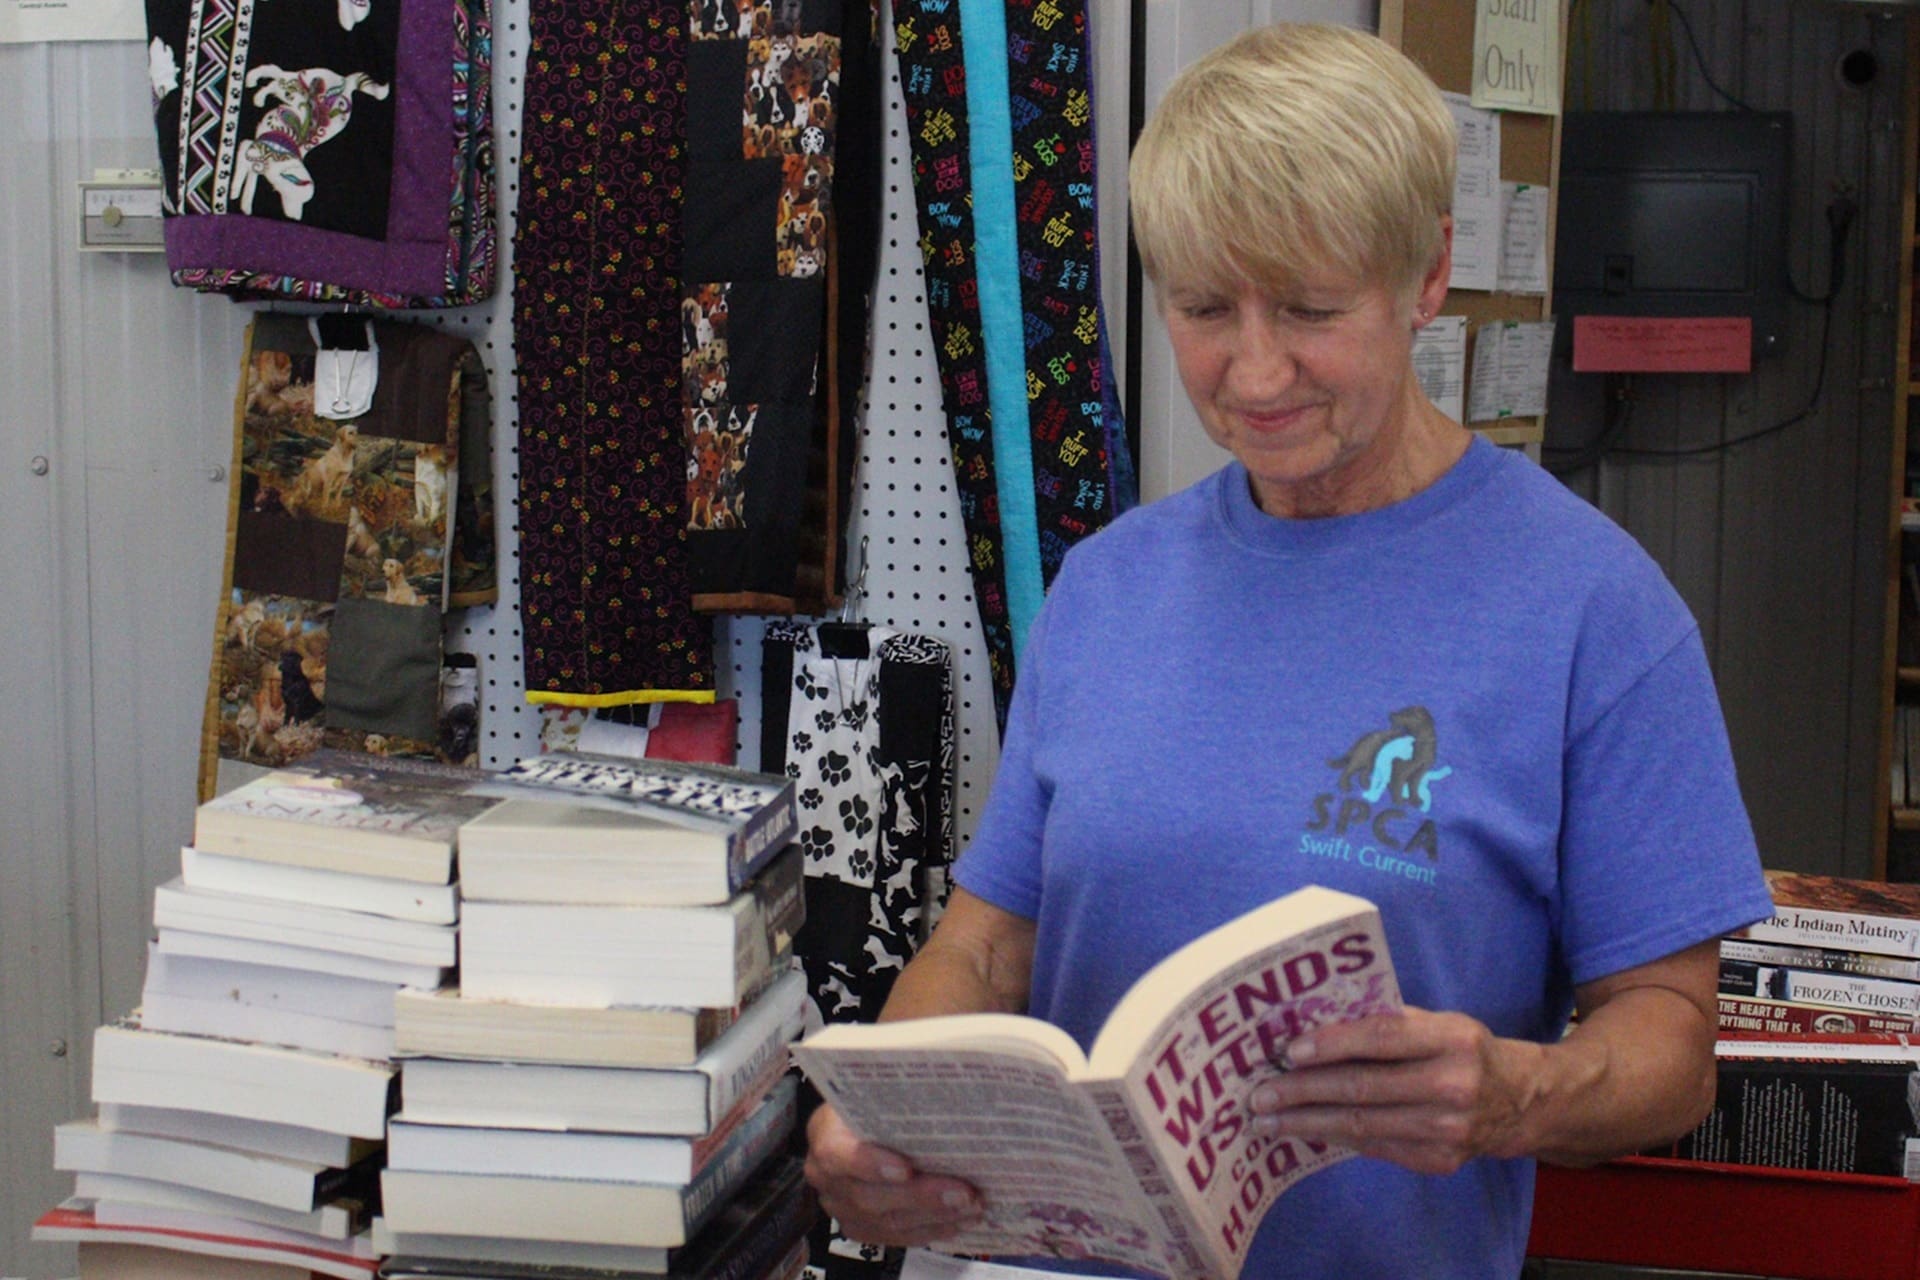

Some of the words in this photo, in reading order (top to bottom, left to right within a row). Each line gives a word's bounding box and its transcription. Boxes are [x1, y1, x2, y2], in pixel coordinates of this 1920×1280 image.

[1485, 43, 1539, 105] Only
[928, 202, 951, 216] BOW
[1042, 226, 1066, 248] YOU
[1304, 792, 1439, 863] SPCA
[1299, 834, 1352, 862] Swift
[1357, 846, 1439, 887] Current
[1793, 913, 1845, 934] Indian
[1848, 919, 1910, 943] Mutiny
[1781, 955, 1836, 969] CRAZY
[1792, 985, 1854, 1003] FROZEN
[1857, 992, 1920, 1011] CHOSEN
[1848, 982, 1867, 992] THE
[1145, 1032, 1186, 1115] IT
[1198, 932, 1376, 1048] ENDS
[1718, 1000, 1737, 1014] THE
[1738, 1002, 1771, 1018] HEART
[1773, 1007, 1788, 1020] OF
[1718, 1013, 1763, 1031] RYTHING
[1765, 1019, 1789, 1033] THAT
[1791, 1022, 1802, 1033] IS
[1164, 1008, 1303, 1149] WITH
[1185, 1098, 1244, 1193] US
